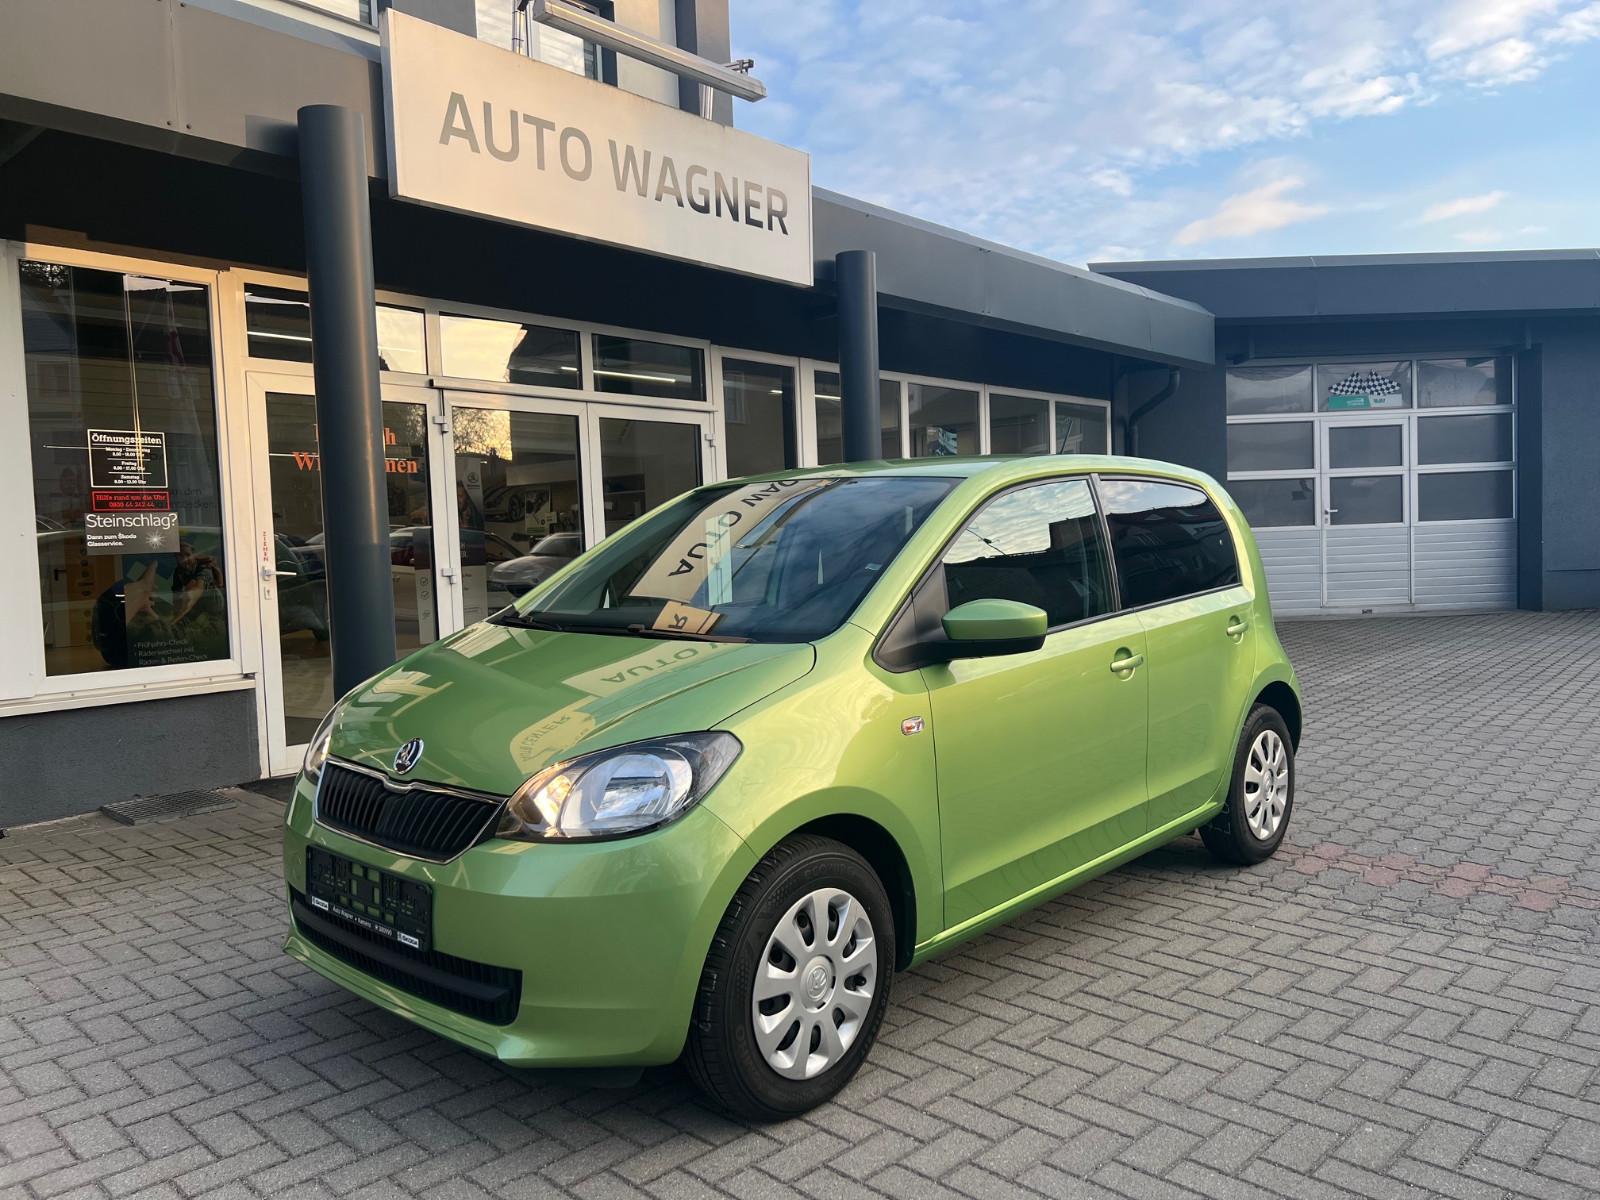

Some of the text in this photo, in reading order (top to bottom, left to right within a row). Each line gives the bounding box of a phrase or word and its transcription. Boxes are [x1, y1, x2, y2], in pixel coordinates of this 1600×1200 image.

[438, 91, 789, 236] AUTO WAGNER
[91, 432, 162, 445] Öffnungszeiten
[86, 513, 178, 530] Steinschlag?
[118, 532, 137, 540] Škoda
